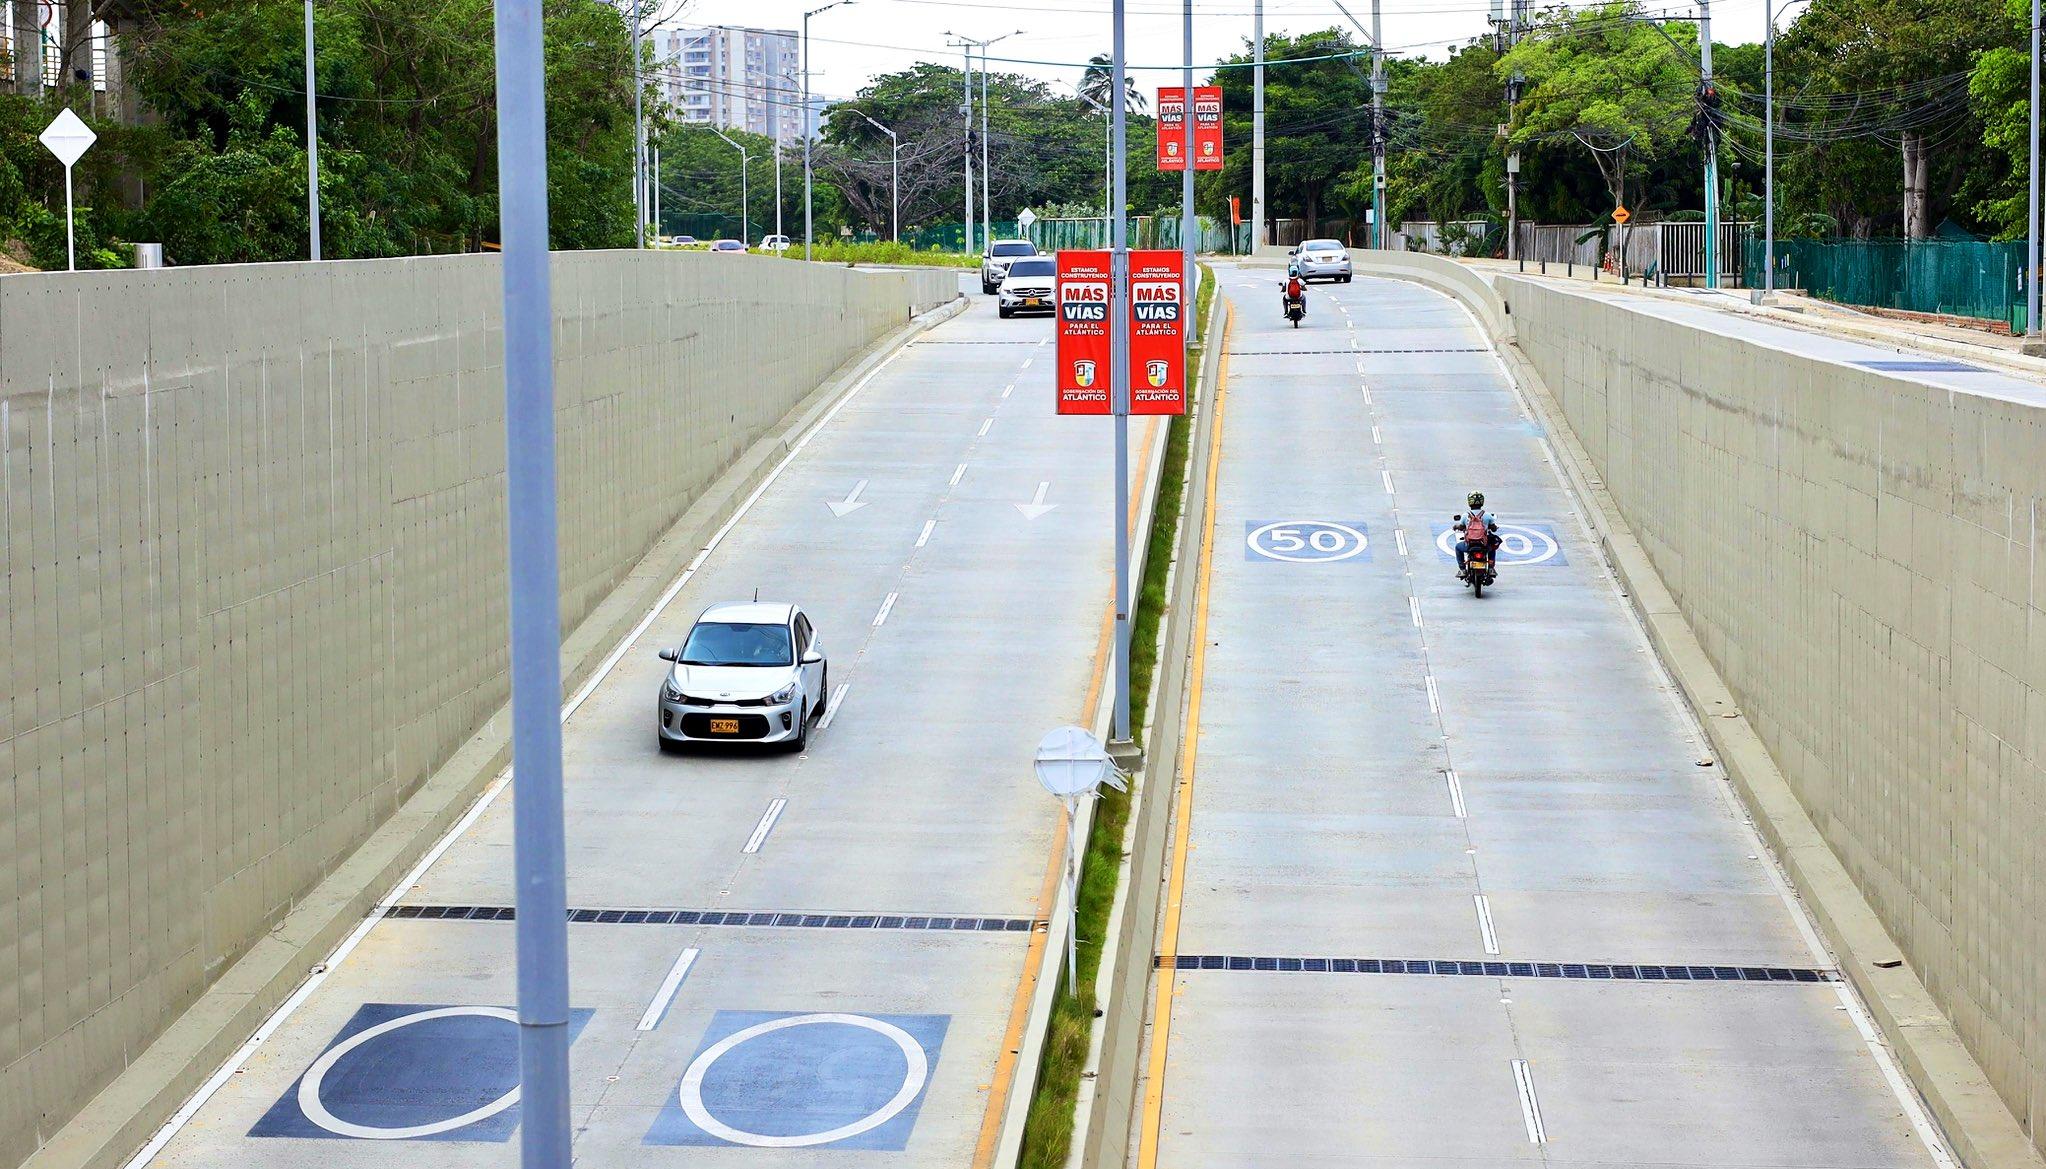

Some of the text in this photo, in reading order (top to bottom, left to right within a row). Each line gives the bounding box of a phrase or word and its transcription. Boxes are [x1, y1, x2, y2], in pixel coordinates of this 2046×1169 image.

[1162, 104, 1182, 112] MÁS
[1197, 114, 1218, 122] VÍAS
[1065, 286, 1104, 301] MÁS
[1137, 286, 1176, 301] MÁS
[1065, 304, 1104, 320] VÍAS
[1136, 304, 1176, 320] VÍAS
[1270, 529, 1346, 552] 50
